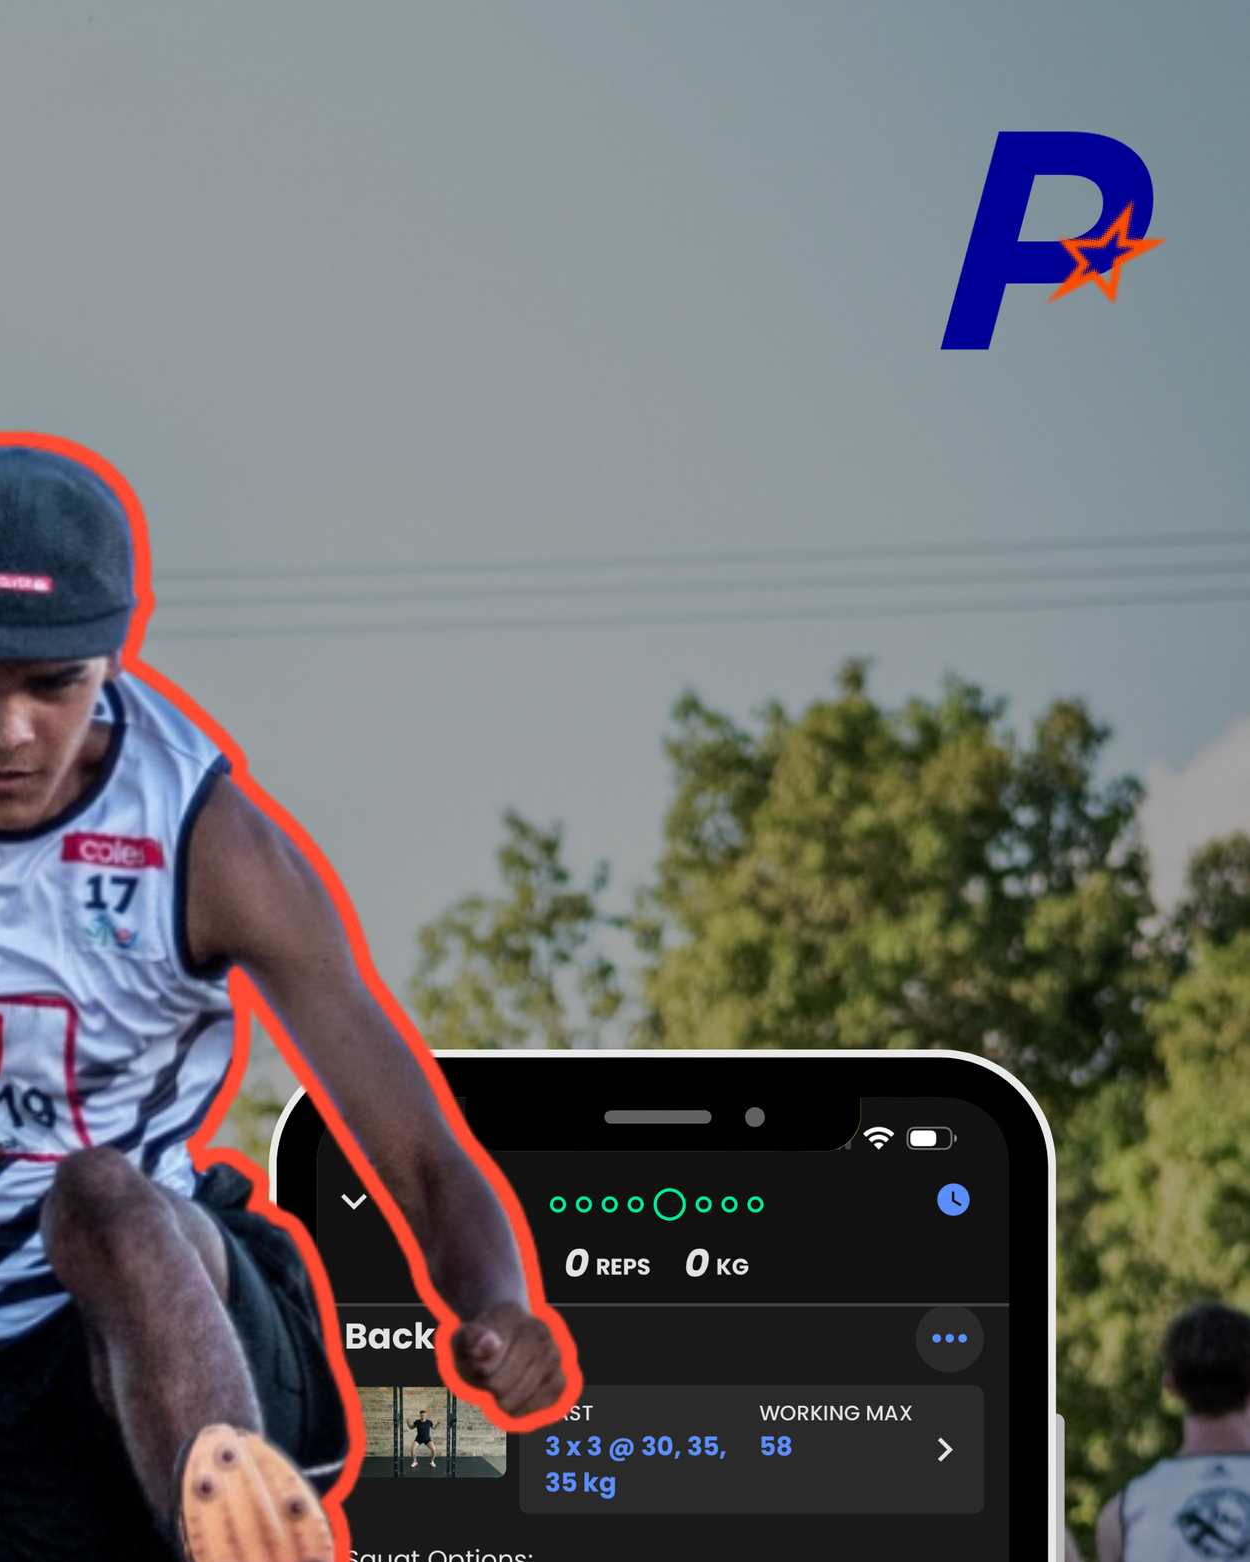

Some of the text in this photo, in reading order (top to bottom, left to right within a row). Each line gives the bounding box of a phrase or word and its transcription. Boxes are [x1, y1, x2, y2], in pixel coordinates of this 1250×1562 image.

[84, 873, 140, 915] 17
[565, 1248, 651, 1278] 0 REPS
[685, 1248, 749, 1278] 0 KG
[345, 1321, 436, 1350] Back
[759, 1404, 913, 1421] WORKING MAX
[545, 1435, 727, 1462] 3 x 3 @ 30, 35,
[760, 1435, 792, 1457] 58
[545, 1471, 616, 1500] 35 kg
